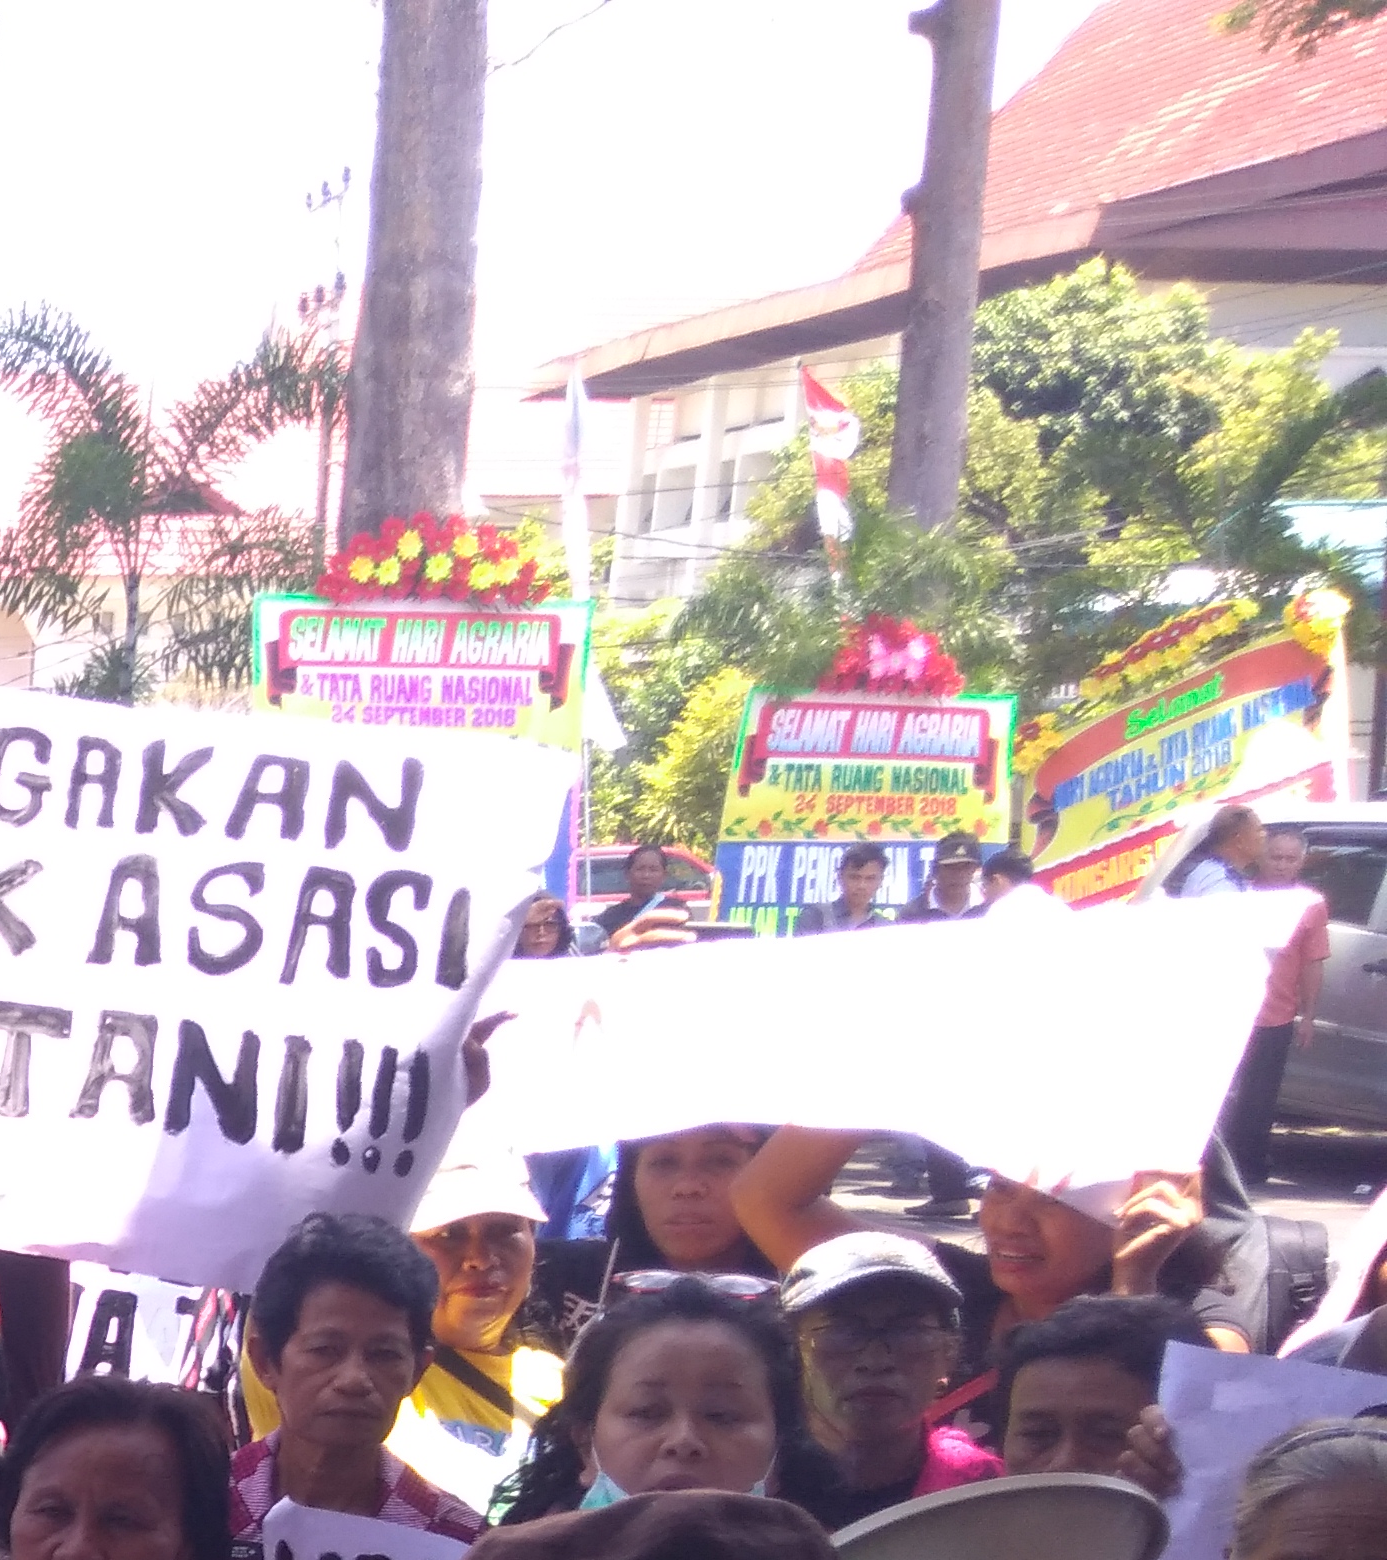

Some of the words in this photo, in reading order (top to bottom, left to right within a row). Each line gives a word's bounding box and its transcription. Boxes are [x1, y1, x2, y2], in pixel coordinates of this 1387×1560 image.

[289, 619, 385, 660] SELAMAT
[392, 621, 448, 664] HARI
[450, 622, 551, 666] AGRARIA
[300, 677, 315, 696] &
[316, 674, 363, 703] TATA
[370, 674, 431, 703] RUANG
[441, 675, 533, 706] NASIONAL
[1124, 671, 1224, 740] Selamat
[331, 704, 355, 722] 24
[362, 705, 466, 728] SEPTEMBER
[473, 707, 516, 728] 2018
[769, 707, 849, 752] SELAMAT
[854, 709, 894, 754] HARI
[898, 711, 981, 757] AGRARIA
[769, 765, 782, 788] &
[784, 761, 823, 792] TATA
[831, 764, 884, 794] RUANG
[892, 766, 969, 796] NASIONAL
[1106, 760, 1188, 812] TAHUN
[793, 793, 817, 814] 24
[827, 794, 913, 816] SEPTEMBER
[920, 795, 958, 816] 2018
[737, 845, 782, 904] PPK
[85, 853, 474, 990] ASASI
